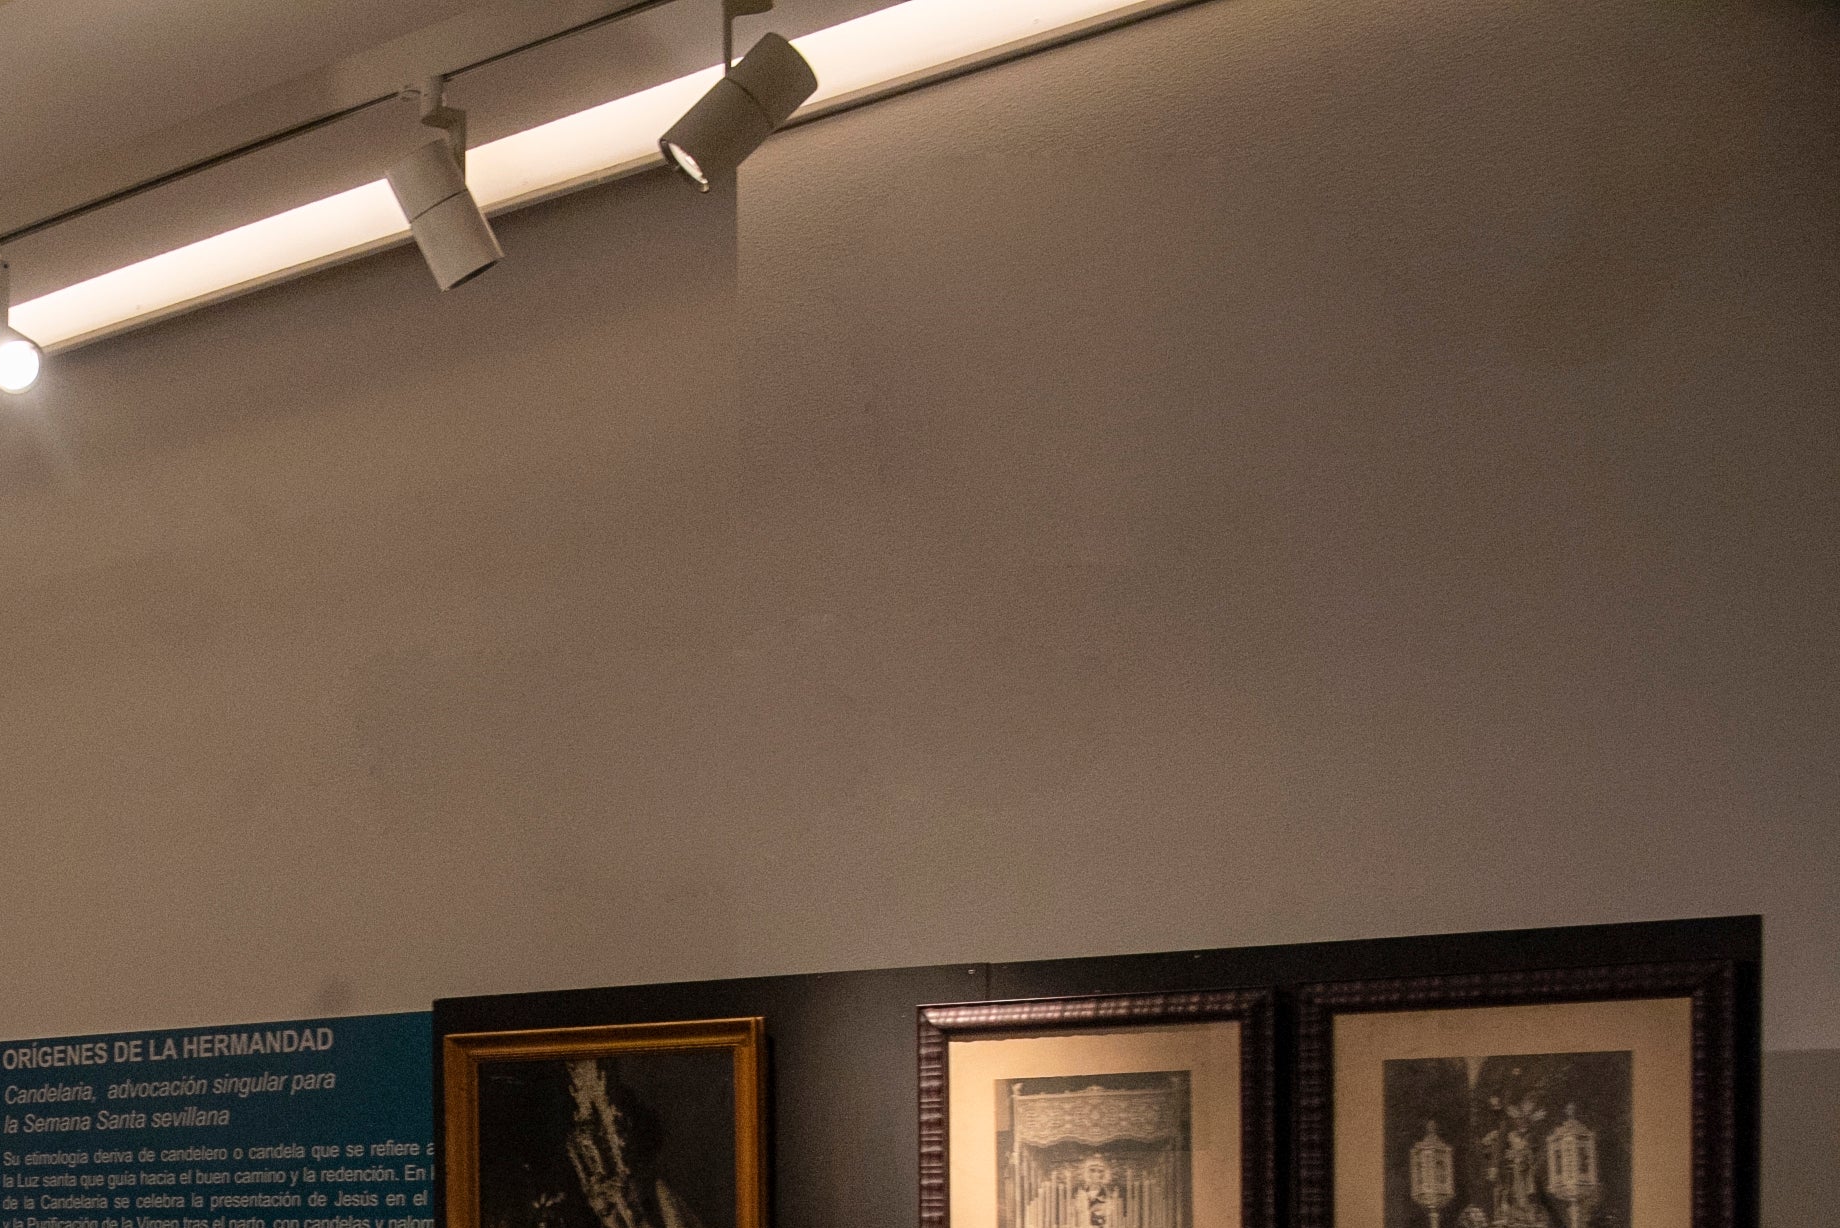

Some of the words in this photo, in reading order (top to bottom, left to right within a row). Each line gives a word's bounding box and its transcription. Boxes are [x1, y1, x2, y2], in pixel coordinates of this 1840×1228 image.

[3, 1042, 108, 1070] ORÍGENES
[114, 1041, 142, 1062] DE
[149, 1038, 178, 1060] LA
[183, 1028, 334, 1059] HERMANDAD
[5, 1082, 96, 1104] Candelaria,
[107, 1075, 207, 1099] advocación
[212, 1071, 288, 1098] singular
[290, 1072, 336, 1095] para
[4, 1115, 18, 1134] la
[23, 1113, 91, 1133] Semana
[96, 1109, 146, 1130] Santa
[150, 1106, 230, 1129] sevillana
[3, 1151, 20, 1166] Su
[93, 1148, 133, 1164] deriva
[138, 1147, 155, 1163] de
[160, 1144, 228, 1163] candelero
[233, 1147, 243, 1160] o
[248, 1143, 305, 1159] candela
[311, 1144, 340, 1162] que
[346, 1144, 364, 1157] se
[370, 1140, 420, 1157] refiere
[3, 1174, 14, 1188] la
[17, 1173, 39, 1188] Luz
[42, 1173, 77, 1187] santa
[80, 1174, 104, 1190] que
[140, 1170, 175, 1185] hacia
[180, 1170, 193, 1184] el
[196, 1169, 230, 1184] buen
[234, 1168, 286, 1183] camino
[290, 1170, 299, 1187] y
[303, 1167, 316, 1182] la
[321, 1165, 399, 1182] redención.
[404, 1164, 425, 1181] En
[2, 1196, 18, 1209] de
[24, 1196, 35, 1209] la
[40, 1194, 108, 1209] Candelaria
[114, 1196, 130, 1208] se
[136, 1193, 185, 1209] celebra
[191, 1192, 203, 1208] la
[210, 1191, 302, 1212] presentación
[307, 1191, 327, 1207] de
[334, 1190, 379, 1207] Jesús
[385, 1193, 406, 1207] en
[413, 1190, 428, 1207] el
